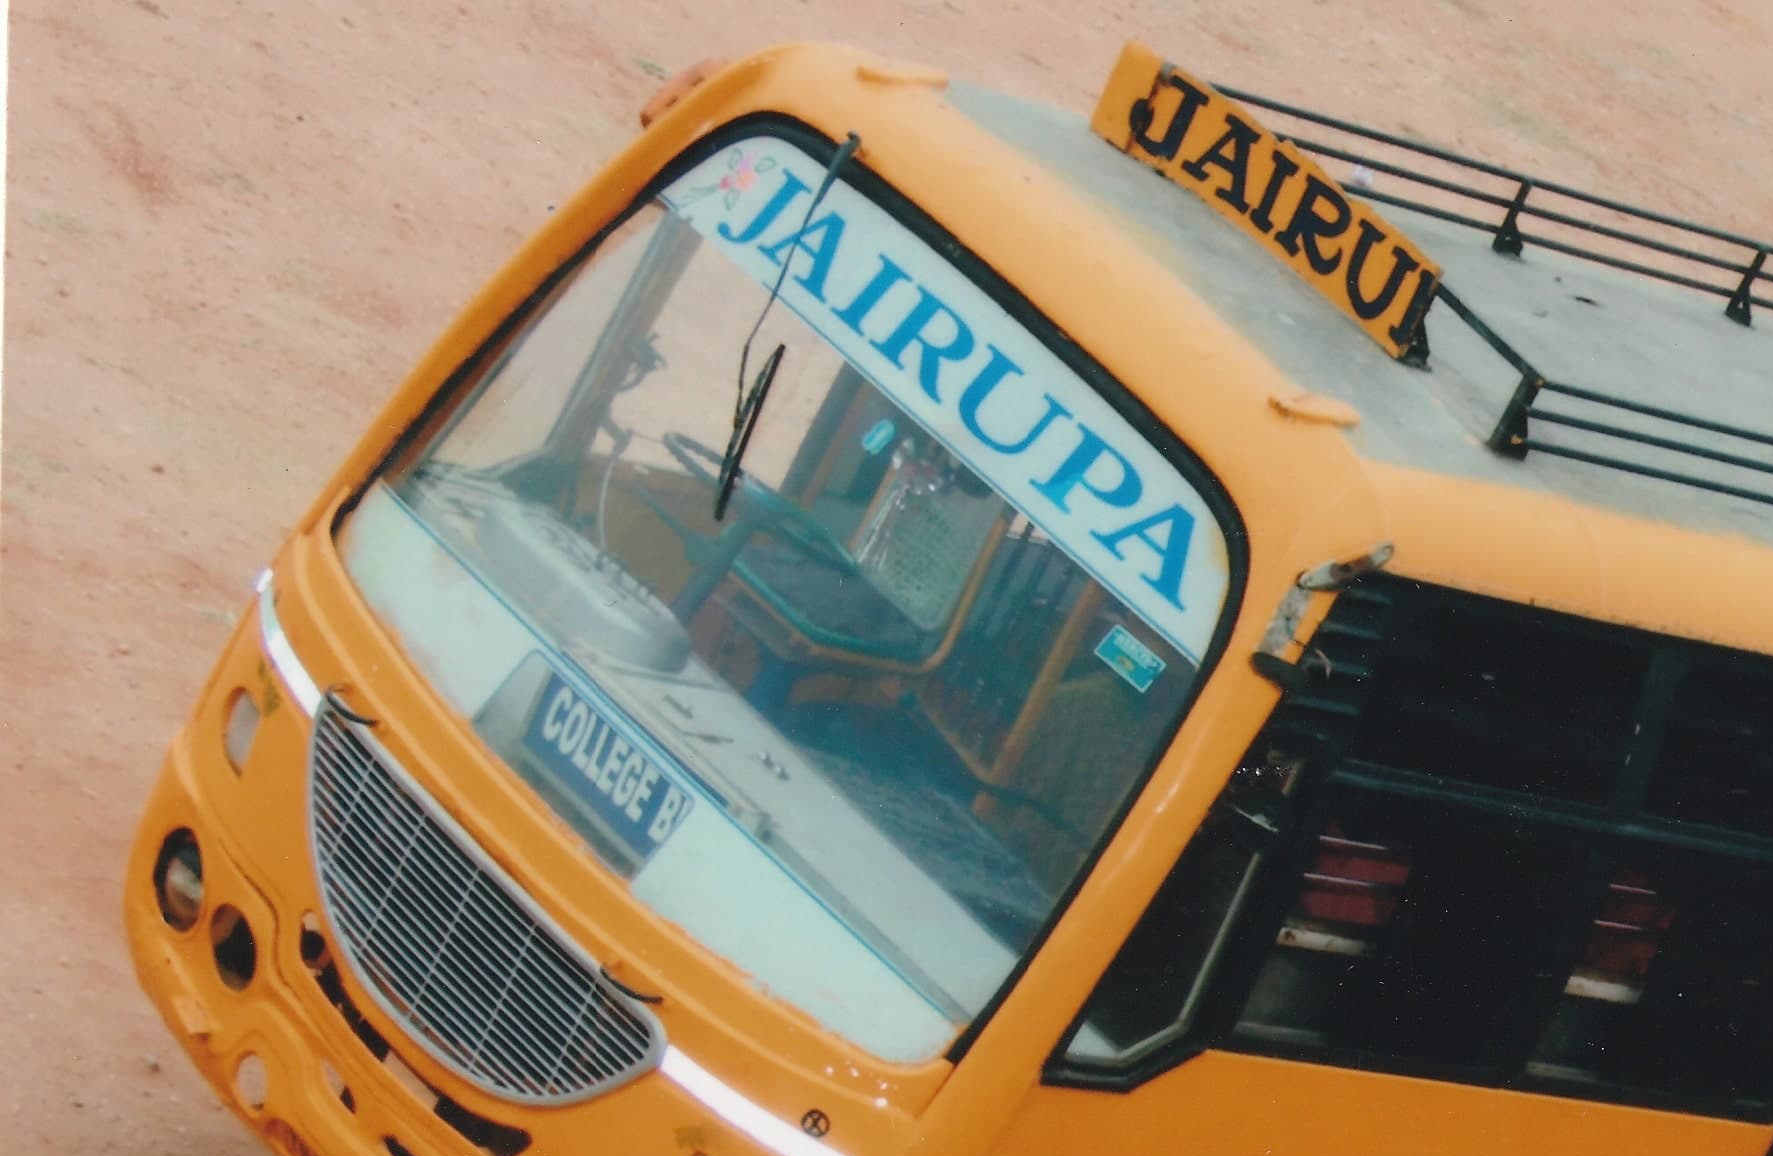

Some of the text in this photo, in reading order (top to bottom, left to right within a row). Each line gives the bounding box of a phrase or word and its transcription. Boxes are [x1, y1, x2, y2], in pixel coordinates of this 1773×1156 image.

[717, 167, 1197, 613] JAIRUPA
[542, 686, 690, 844] COLLEGE B
